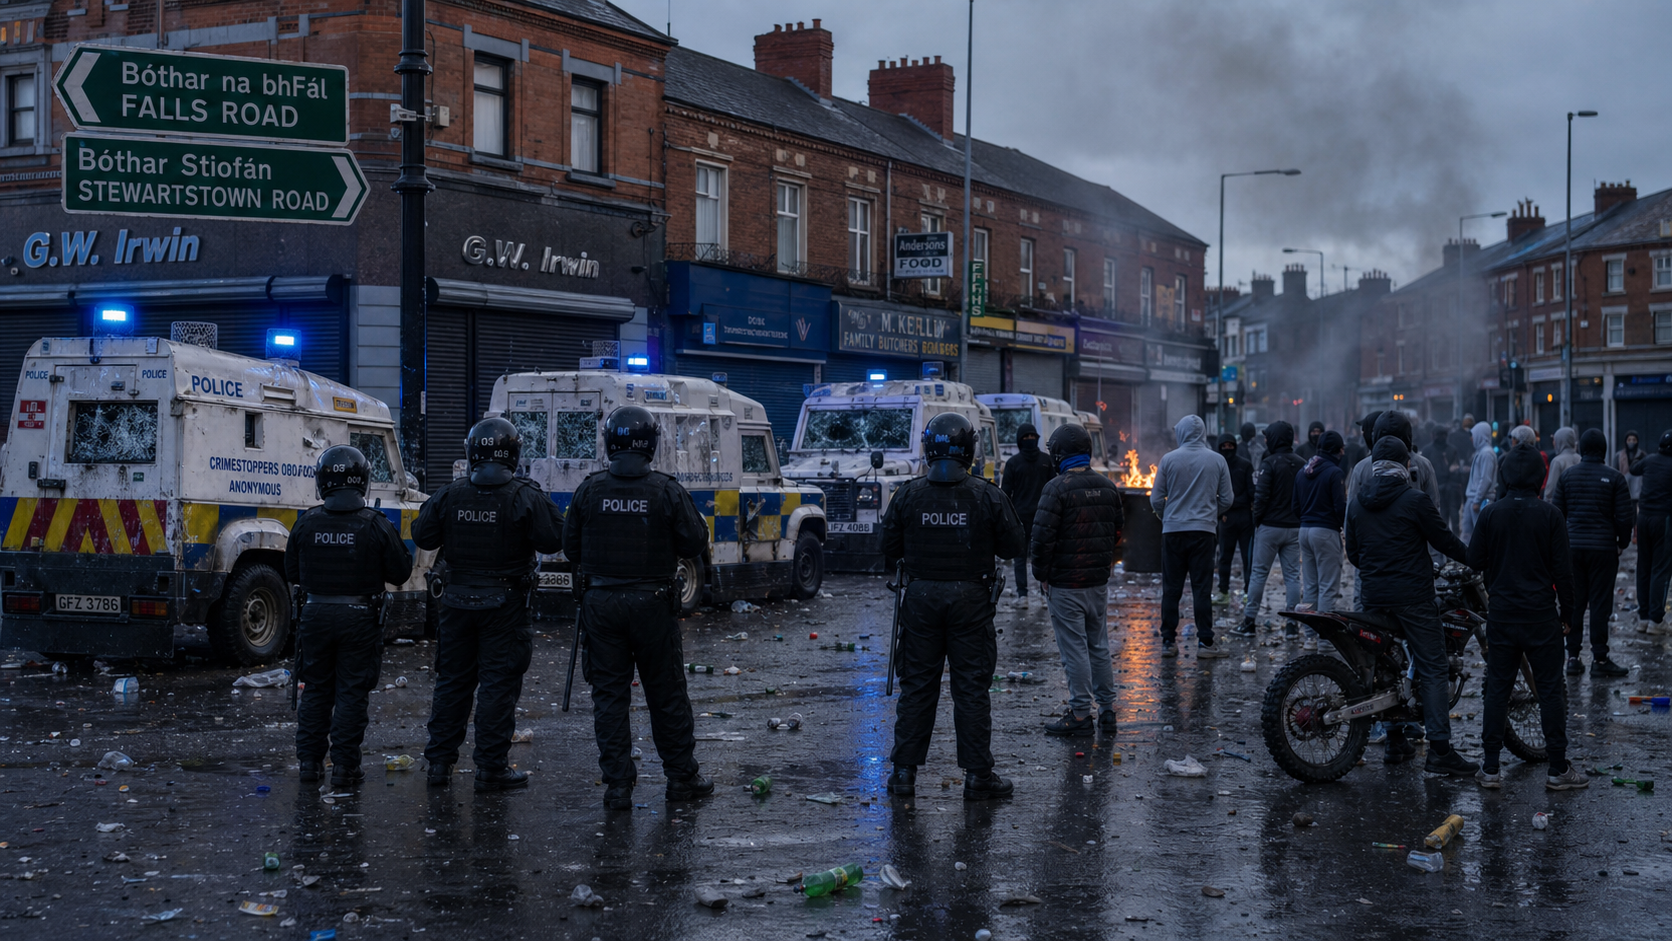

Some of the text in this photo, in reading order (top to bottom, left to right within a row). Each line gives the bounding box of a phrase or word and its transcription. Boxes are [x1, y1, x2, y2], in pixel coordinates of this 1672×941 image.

[122, 61, 328, 99] Bóthar na bhFál
[122, 94, 299, 128] FALLS ROAD
[78, 147, 272, 180] Bóthar Stiofán
[78, 179, 329, 211] STEWARTSTOWN ROAD
[23, 226, 200, 268] G.W. Irwin
[899, 239, 946, 252] Andersons
[462, 235, 600, 278] G.W. Irwin
[900, 258, 943, 270] FOOD
[844, 331, 875, 349] FAMILY
[25, 370, 49, 380] POLICE
[142, 369, 167, 379] POLICE
[191, 375, 244, 398] POLICE
[209, 456, 279, 476] CRIMESTOPPERS
[229, 479, 281, 496] ANONYMOUS
[602, 499, 648, 513] POLICE
[457, 510, 497, 523] POLICE
[922, 512, 967, 526] POLICE
[315, 533, 355, 545] POLICE
[59, 596, 118, 611] GFZ 3786
